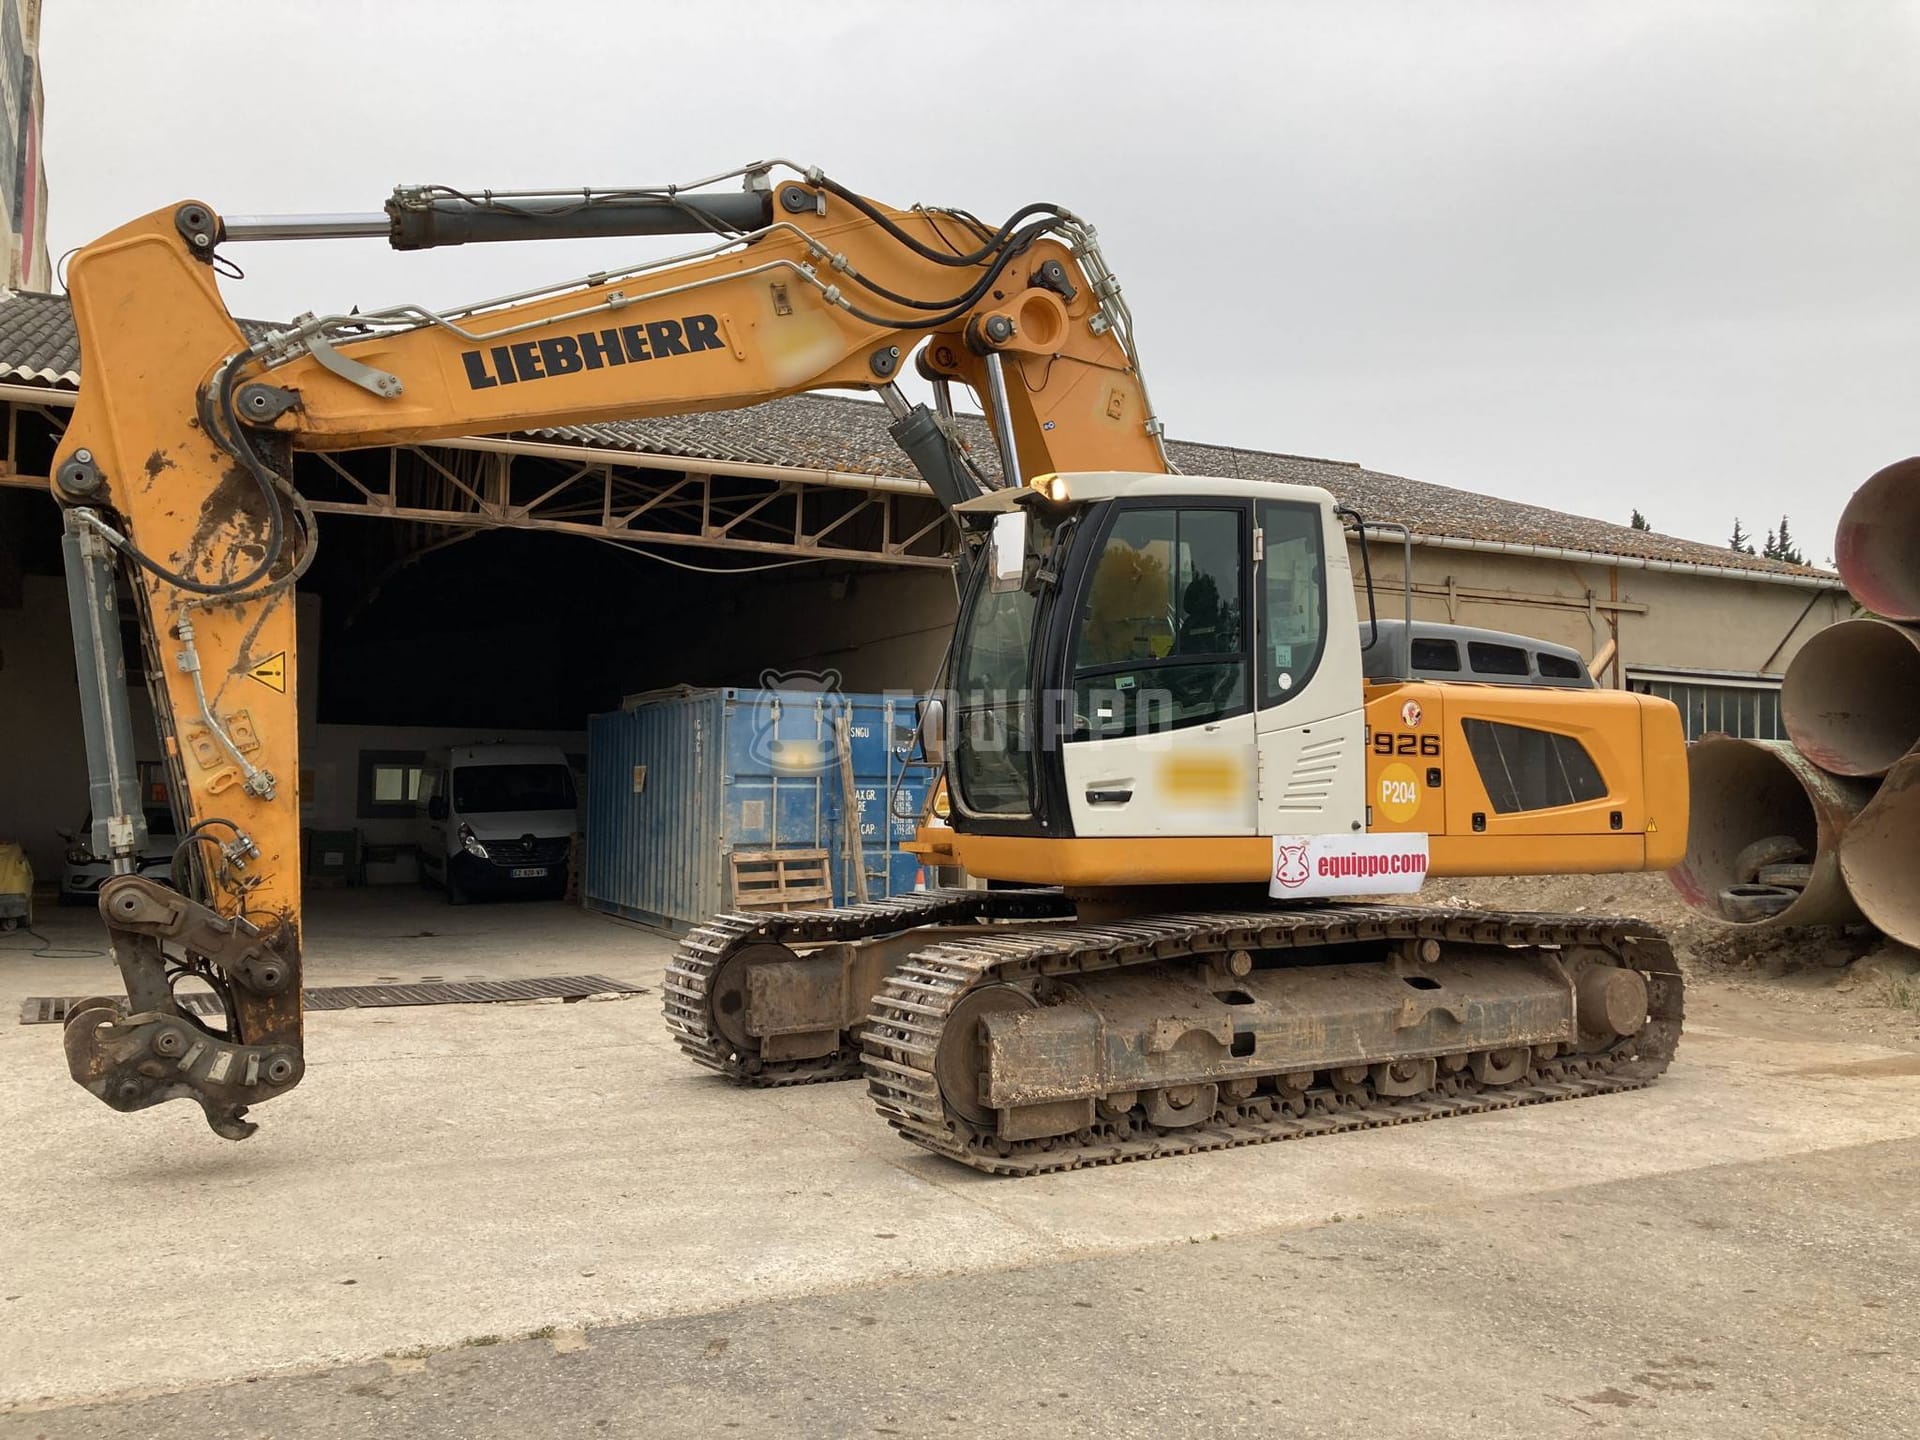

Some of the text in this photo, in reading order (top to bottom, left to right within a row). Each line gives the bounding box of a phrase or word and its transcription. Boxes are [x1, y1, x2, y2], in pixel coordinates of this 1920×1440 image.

[461, 313, 726, 390] LIEBHERR
[1374, 732, 1441, 756] 926
[1382, 780, 1416, 804] P204
[1317, 852, 1427, 879] equippo.com
